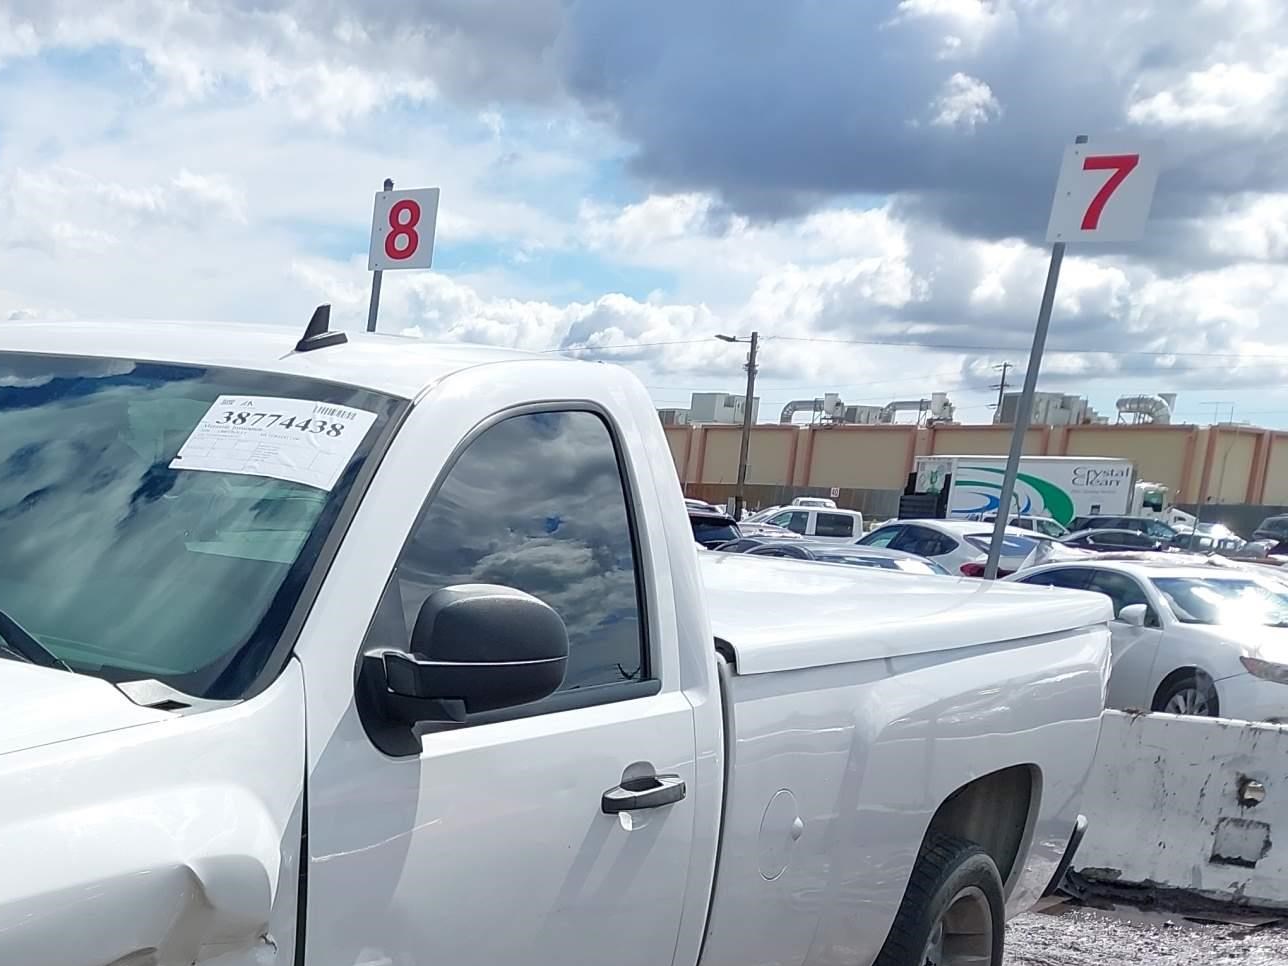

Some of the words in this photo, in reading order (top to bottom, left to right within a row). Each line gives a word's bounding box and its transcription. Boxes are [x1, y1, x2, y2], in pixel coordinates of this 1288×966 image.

[1080, 153, 1140, 231] 7
[383, 198, 422, 261] 8
[215, 410, 345, 438] 38774438
[1071, 475, 1121, 486] Clean
[1072, 466, 1130, 480] Crystal
